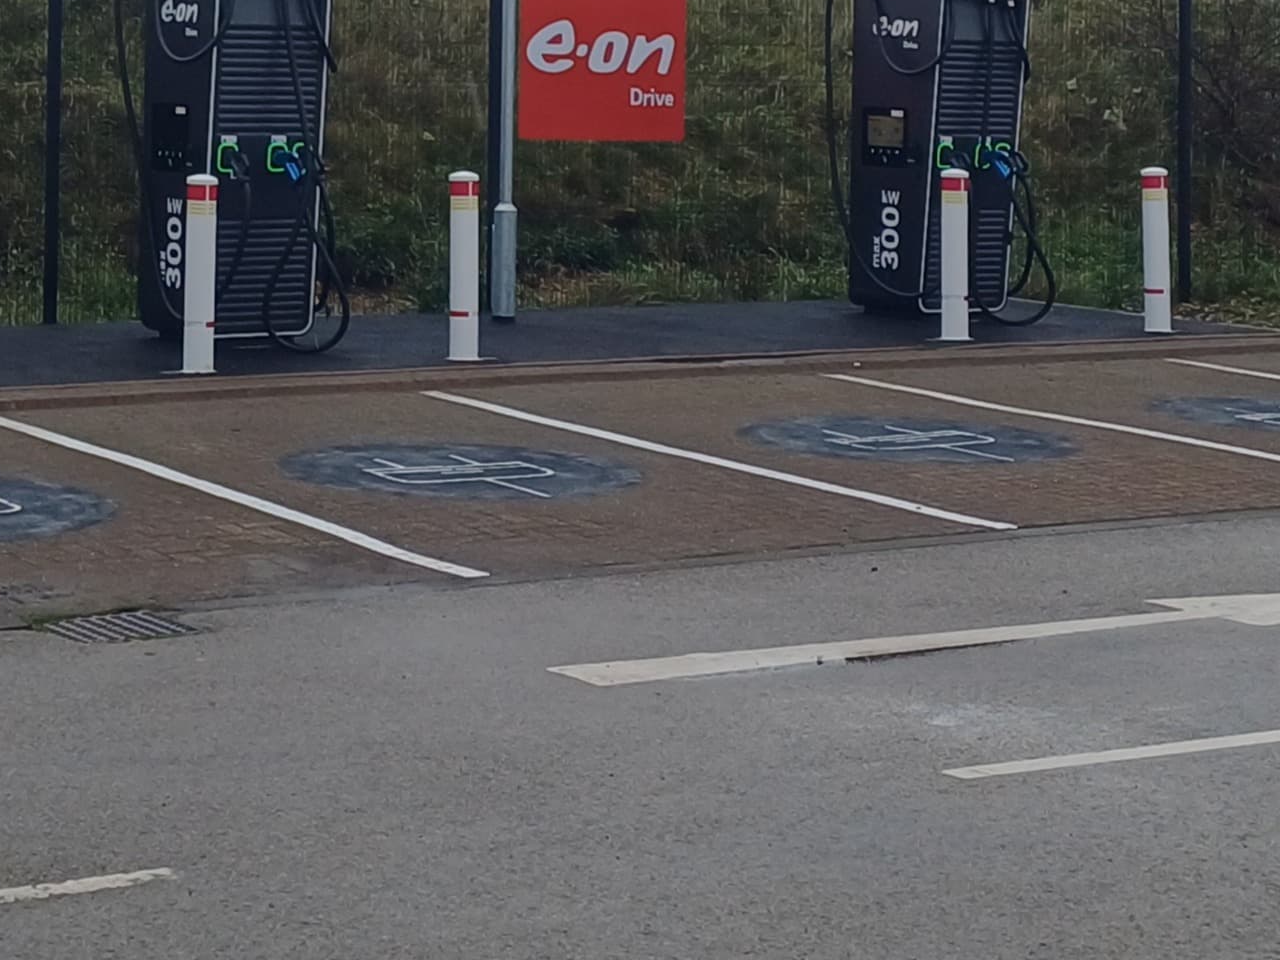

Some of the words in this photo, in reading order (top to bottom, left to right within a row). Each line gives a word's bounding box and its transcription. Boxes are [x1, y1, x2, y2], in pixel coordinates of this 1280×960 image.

[630, 88, 674, 107] Drive
[166, 216, 182, 289] 300
[880, 206, 900, 270] 300
